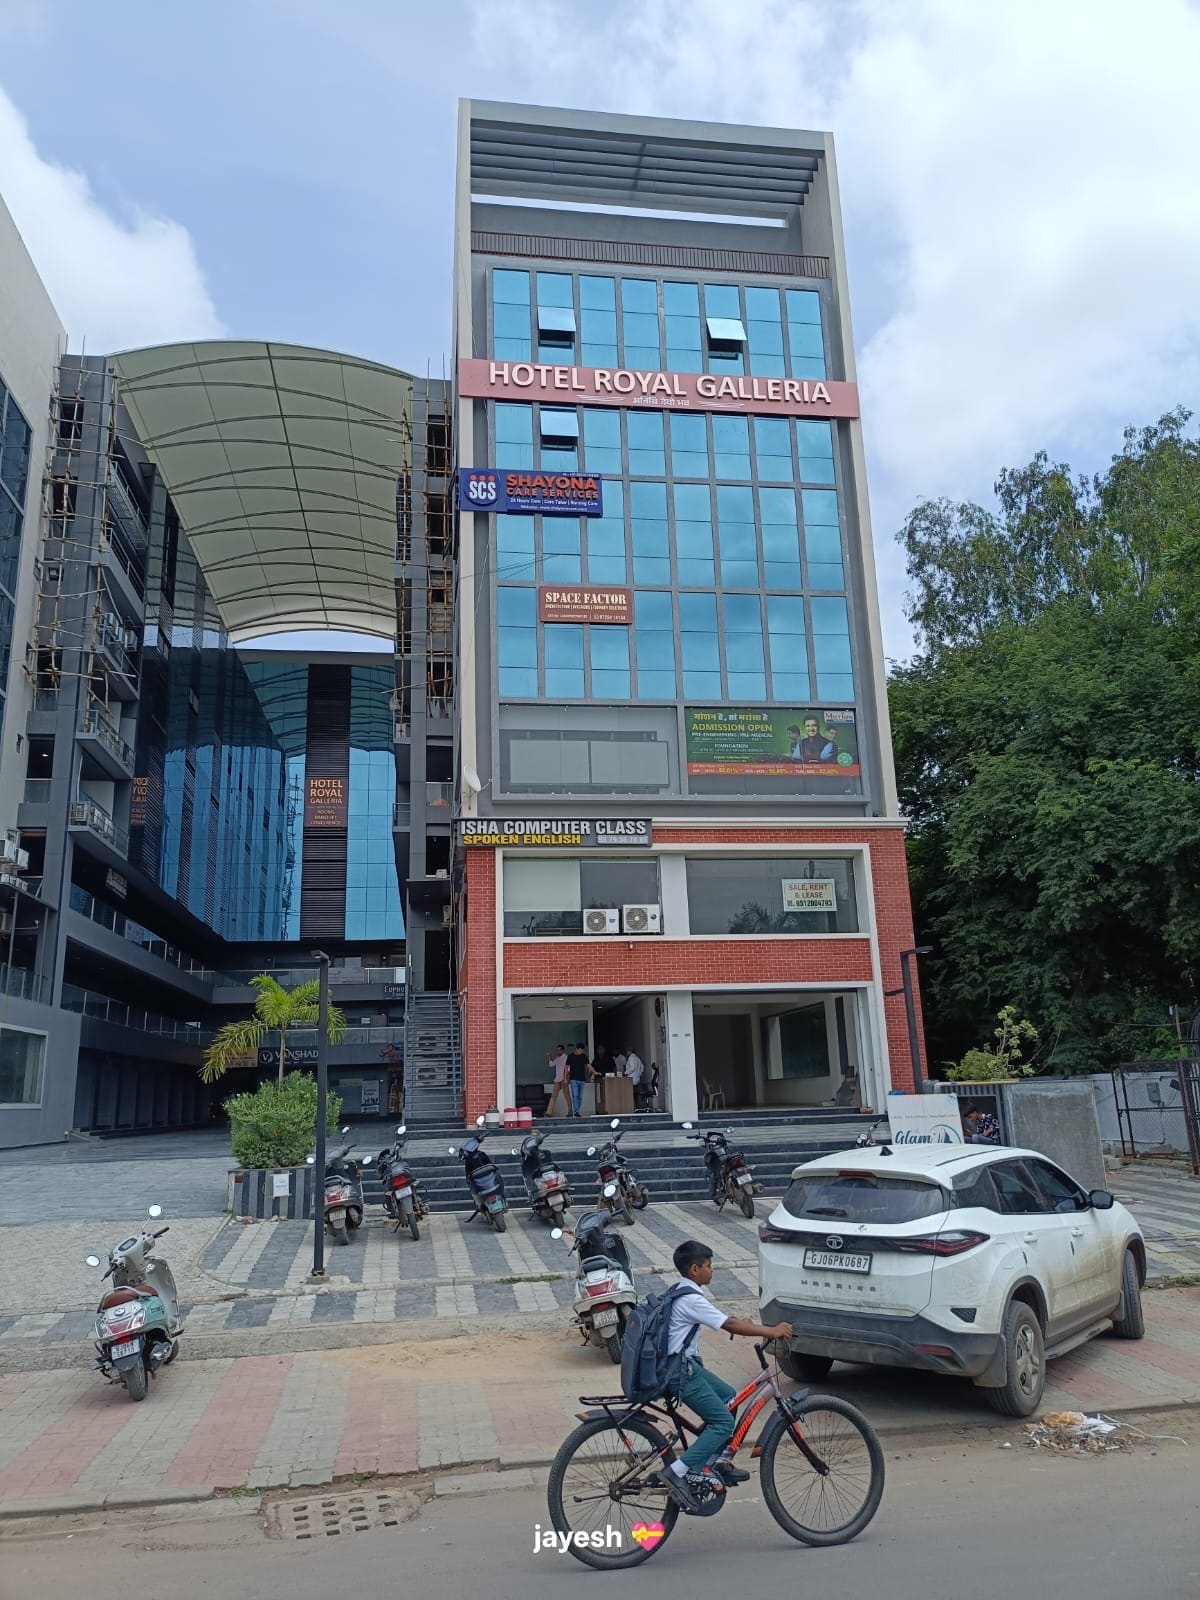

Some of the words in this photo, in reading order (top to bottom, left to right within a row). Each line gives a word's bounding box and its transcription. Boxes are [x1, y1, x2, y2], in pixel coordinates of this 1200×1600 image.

[489, 362, 586, 391] HOTEL
[594, 369, 688, 397] ROYAL
[696, 375, 833, 404] GALLERIA
[506, 474, 598, 490] SHAYONA
[468, 481, 497, 500] SCS
[506, 487, 539, 496] CARE
[542, 489, 599, 499] SERVICES
[545, 592, 581, 603] SPACE
[583, 593, 627, 605] FACTOR
[692, 723, 745, 731] ADMISSION
[747, 724, 773, 732] OPEN
[310, 779, 343, 788] HOTEL
[310, 788, 343, 797] ROYAL
[460, 820, 500, 835] ISHA
[503, 820, 591, 835] COMPUTER
[595, 820, 647, 835] CLASS
[463, 834, 519, 845] SPOKEN
[523, 834, 581, 845] ENGLISH
[809, 883, 828, 891] RENT
[802, 891, 824, 899] LEASE
[895, 1130, 932, 1145] Glam
[811, 1253, 869, 1269] GJ06PK0687
